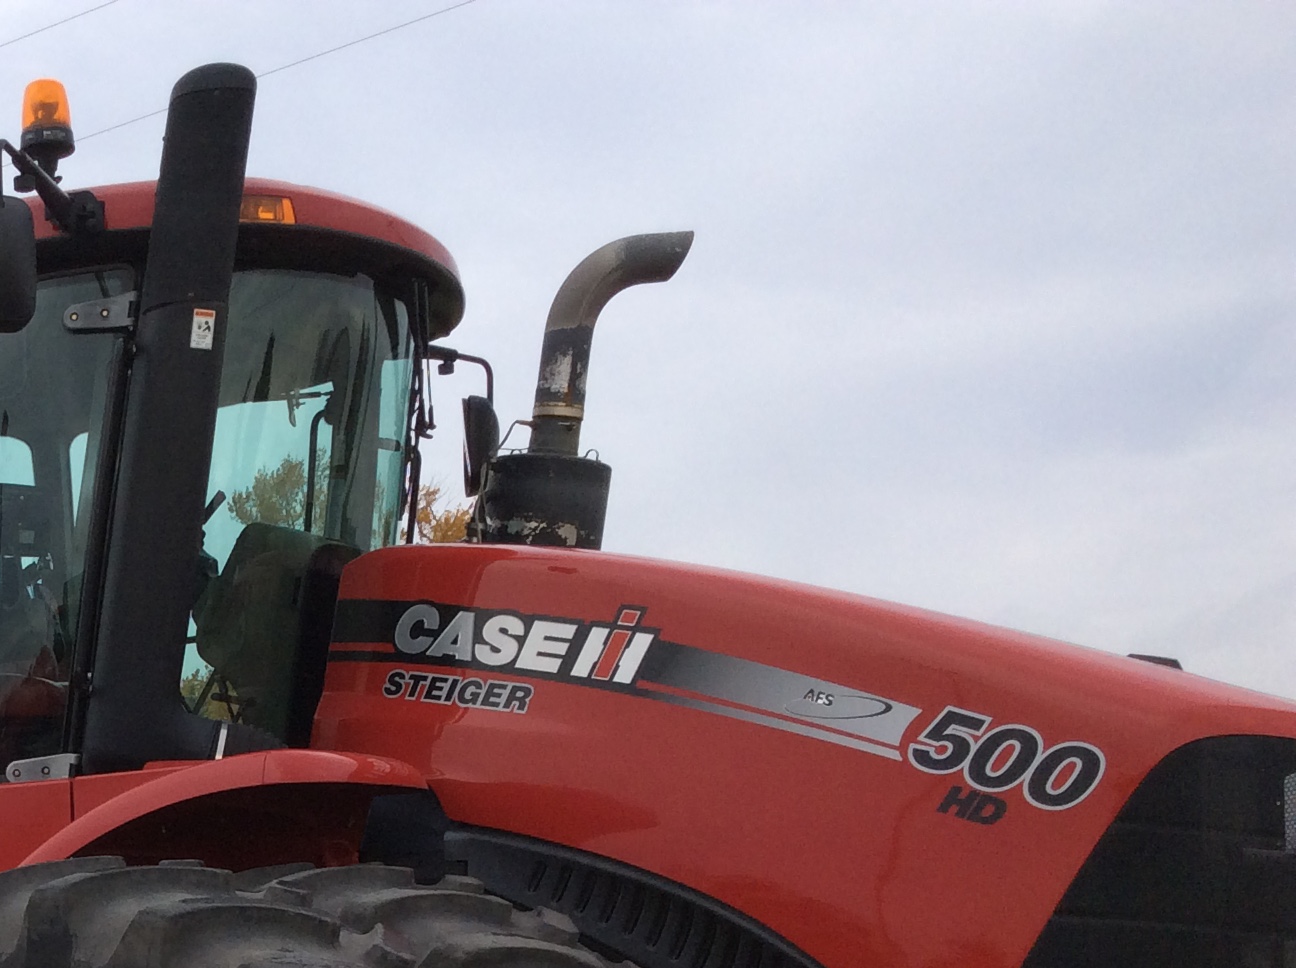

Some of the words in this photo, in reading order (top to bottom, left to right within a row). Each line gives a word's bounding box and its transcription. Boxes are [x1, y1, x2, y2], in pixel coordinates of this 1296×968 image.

[394, 604, 579, 674] CASE
[382, 669, 535, 714] STEIGER
[803, 688, 835, 707] AFS
[907, 705, 1107, 811] 500
[936, 785, 1008, 826] HD
